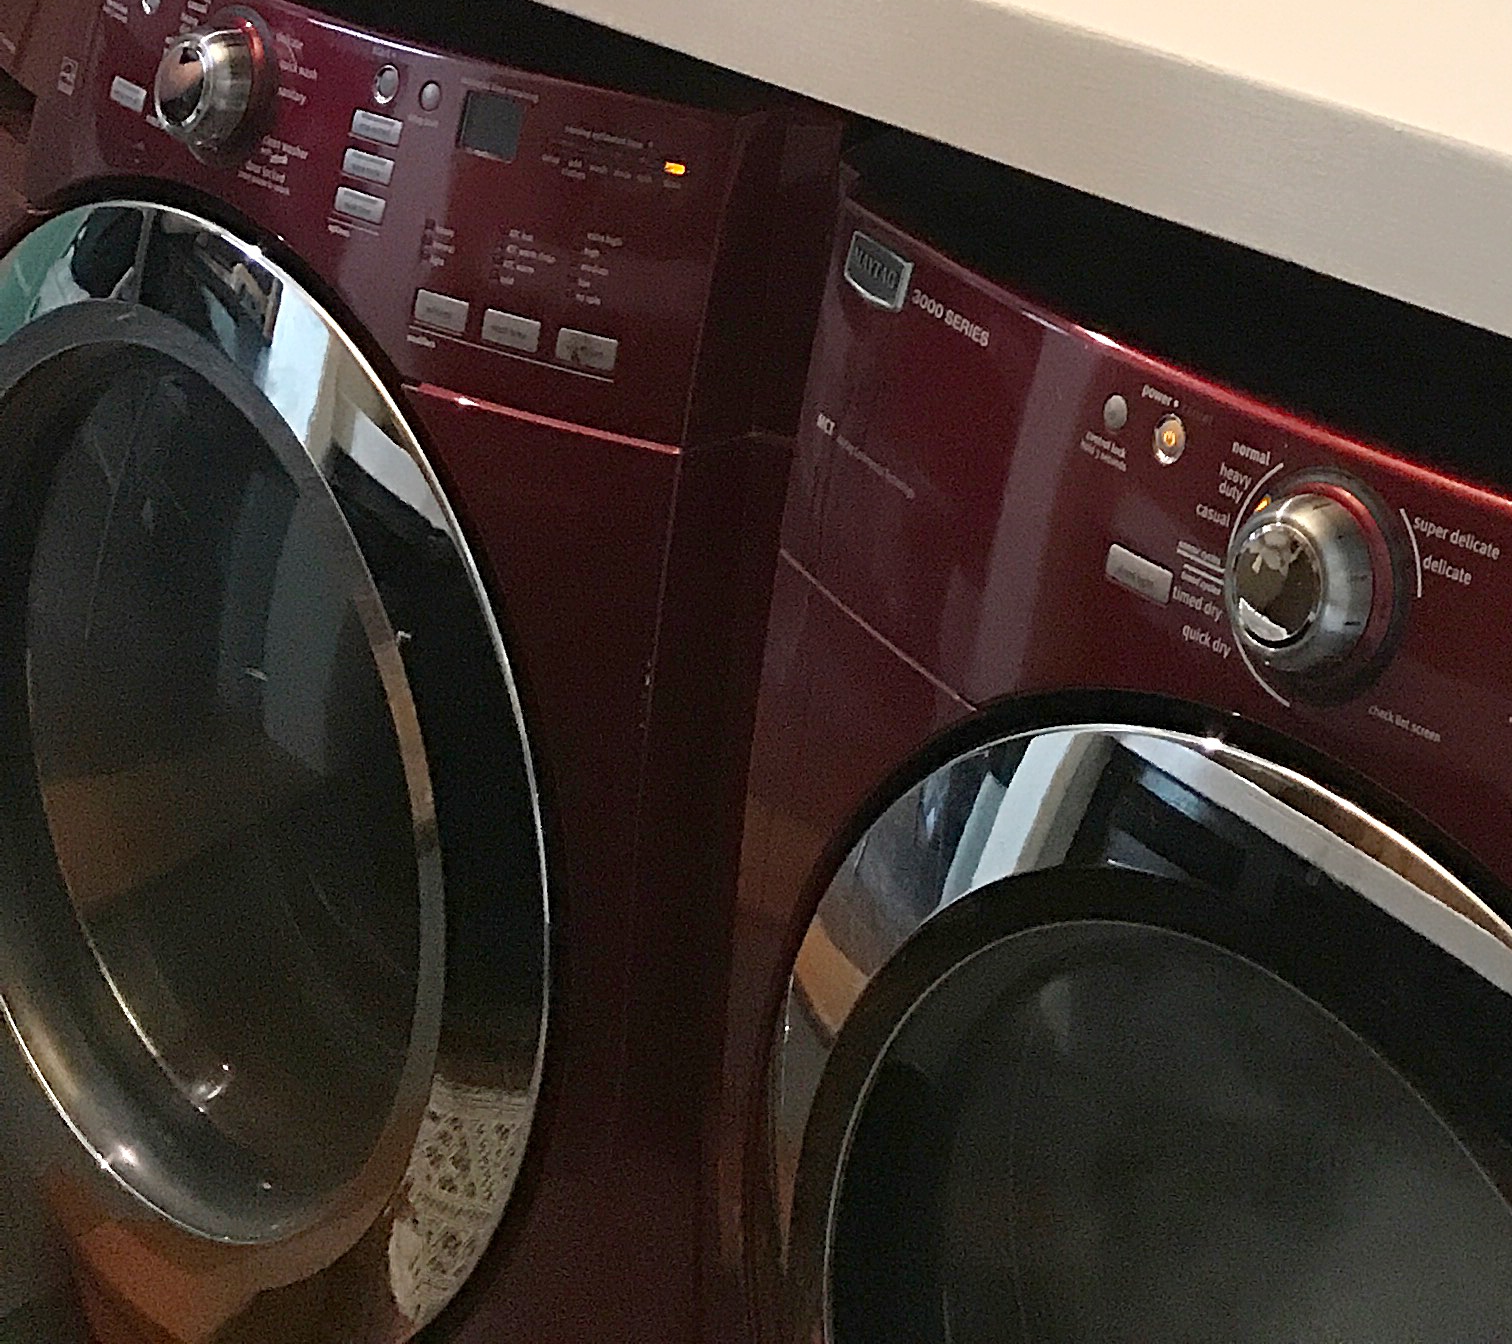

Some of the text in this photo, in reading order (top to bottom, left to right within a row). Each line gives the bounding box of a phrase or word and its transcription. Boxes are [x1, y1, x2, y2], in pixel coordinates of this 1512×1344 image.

[912, 288, 990, 347] 3000 SERIES
[1141, 384, 1173, 406] power
[1231, 441, 1271, 466] normal
[1219, 462, 1252, 489] heavy
[1218, 480, 1243, 504] duty
[1196, 503, 1231, 528] casual
[1413, 516, 1501, 560] super delicate
[1422, 554, 1473, 586] delicate
[1172, 586, 1223, 622] timed dry
[1182, 625, 1231, 659] quick dry
